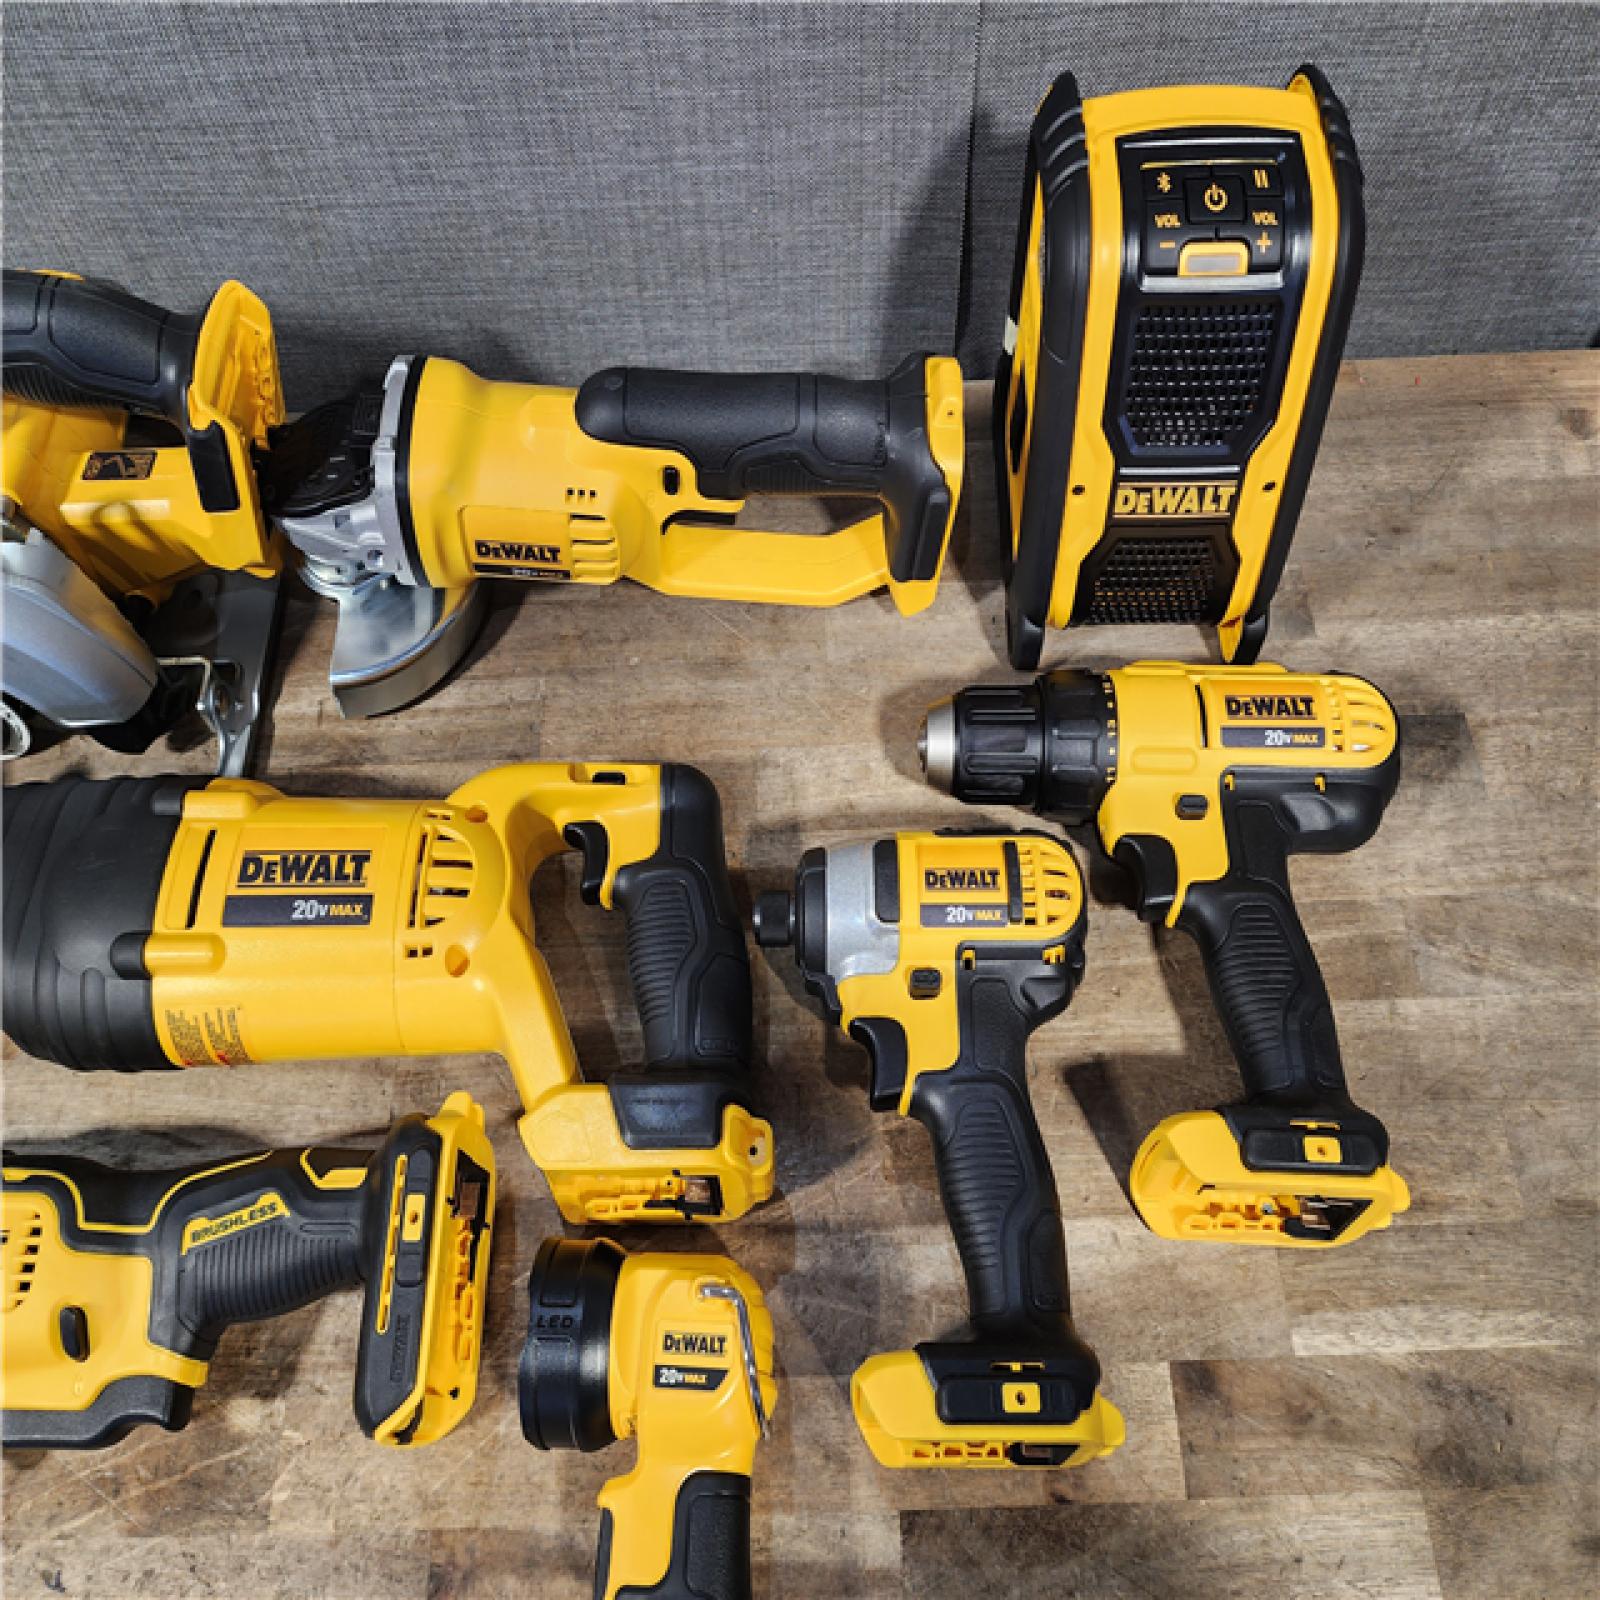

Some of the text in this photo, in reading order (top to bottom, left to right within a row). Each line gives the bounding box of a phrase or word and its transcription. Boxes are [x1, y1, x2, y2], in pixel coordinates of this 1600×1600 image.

[1154, 212, 1181, 228] VOL
[1252, 210, 1278, 226] VOL
[1113, 484, 1237, 515] DEWALT
[475, 541, 561, 564] DEWALT
[1225, 695, 1316, 718] DEWALT
[1292, 733, 1319, 745] MAX
[238, 851, 371, 886] DEWALT
[924, 868, 1000, 890] DEWALT
[329, 903, 364, 917] MAX
[975, 909, 1002, 921] MAX
[662, 1331, 727, 1355] DEWALT
